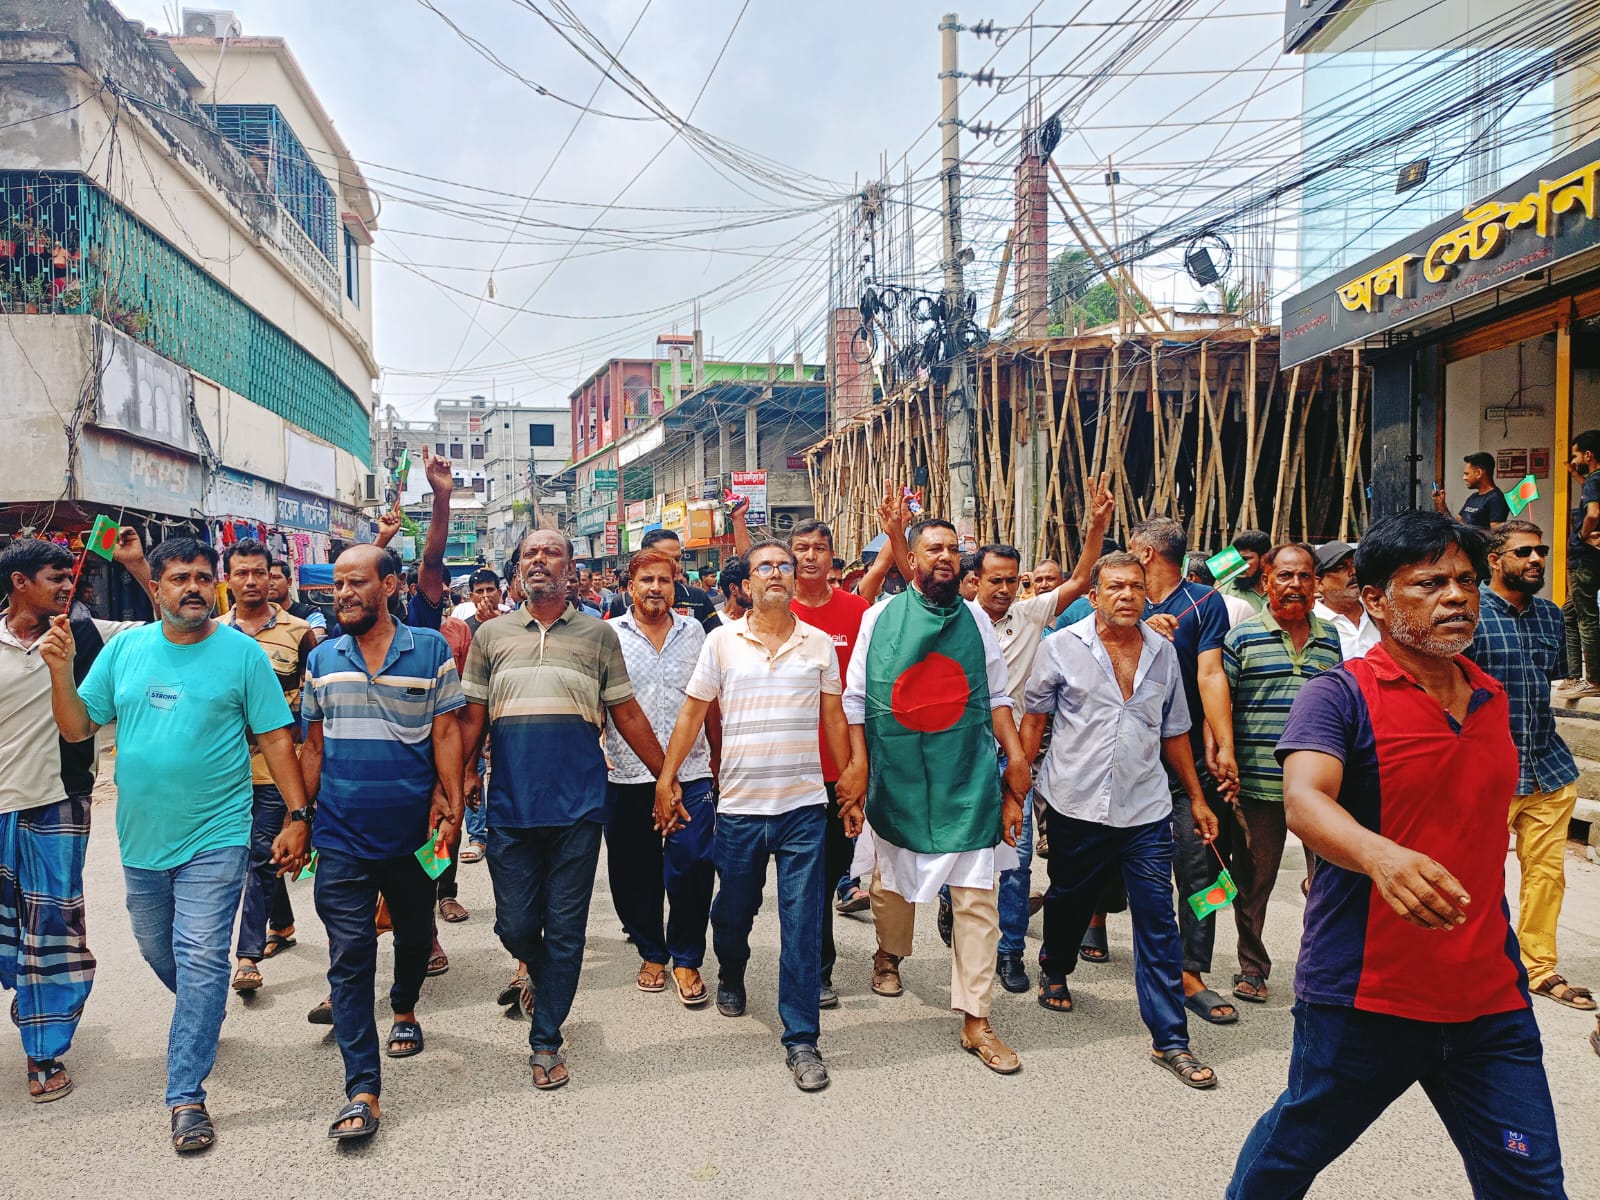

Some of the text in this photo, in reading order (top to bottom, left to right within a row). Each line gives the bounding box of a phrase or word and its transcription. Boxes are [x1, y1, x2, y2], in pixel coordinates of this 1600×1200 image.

[1335, 160, 1600, 314] অল স্টেশন
[151, 692, 178, 700] STRONG
[1507, 1139, 1527, 1152] 28
